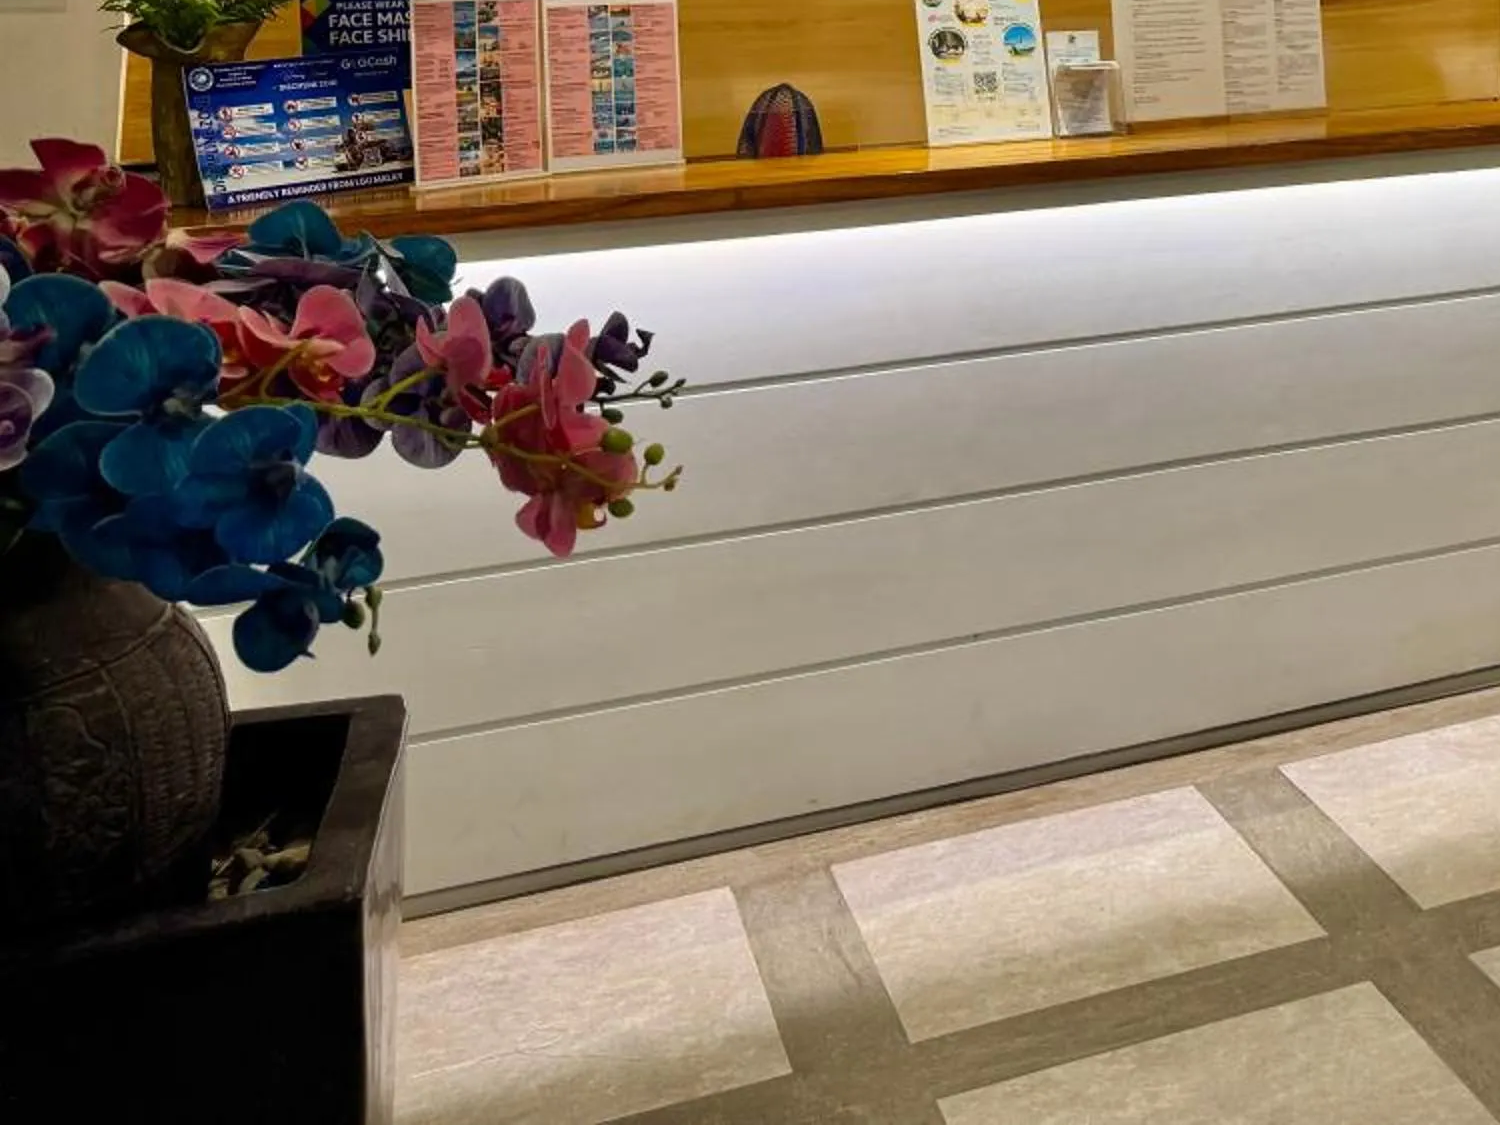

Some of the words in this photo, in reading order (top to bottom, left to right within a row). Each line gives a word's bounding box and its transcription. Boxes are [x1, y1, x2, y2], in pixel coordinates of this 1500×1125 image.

[336, 1, 372, 11] PLEASE
[376, 0, 405, 10] WEAR
[328, 13, 372, 28] FACE
[329, 29, 373, 45] FACE
[236, 189, 280, 203] FRIENDLY
[282, 183, 327, 196] REMINDER
[328, 179, 355, 191] FROM
